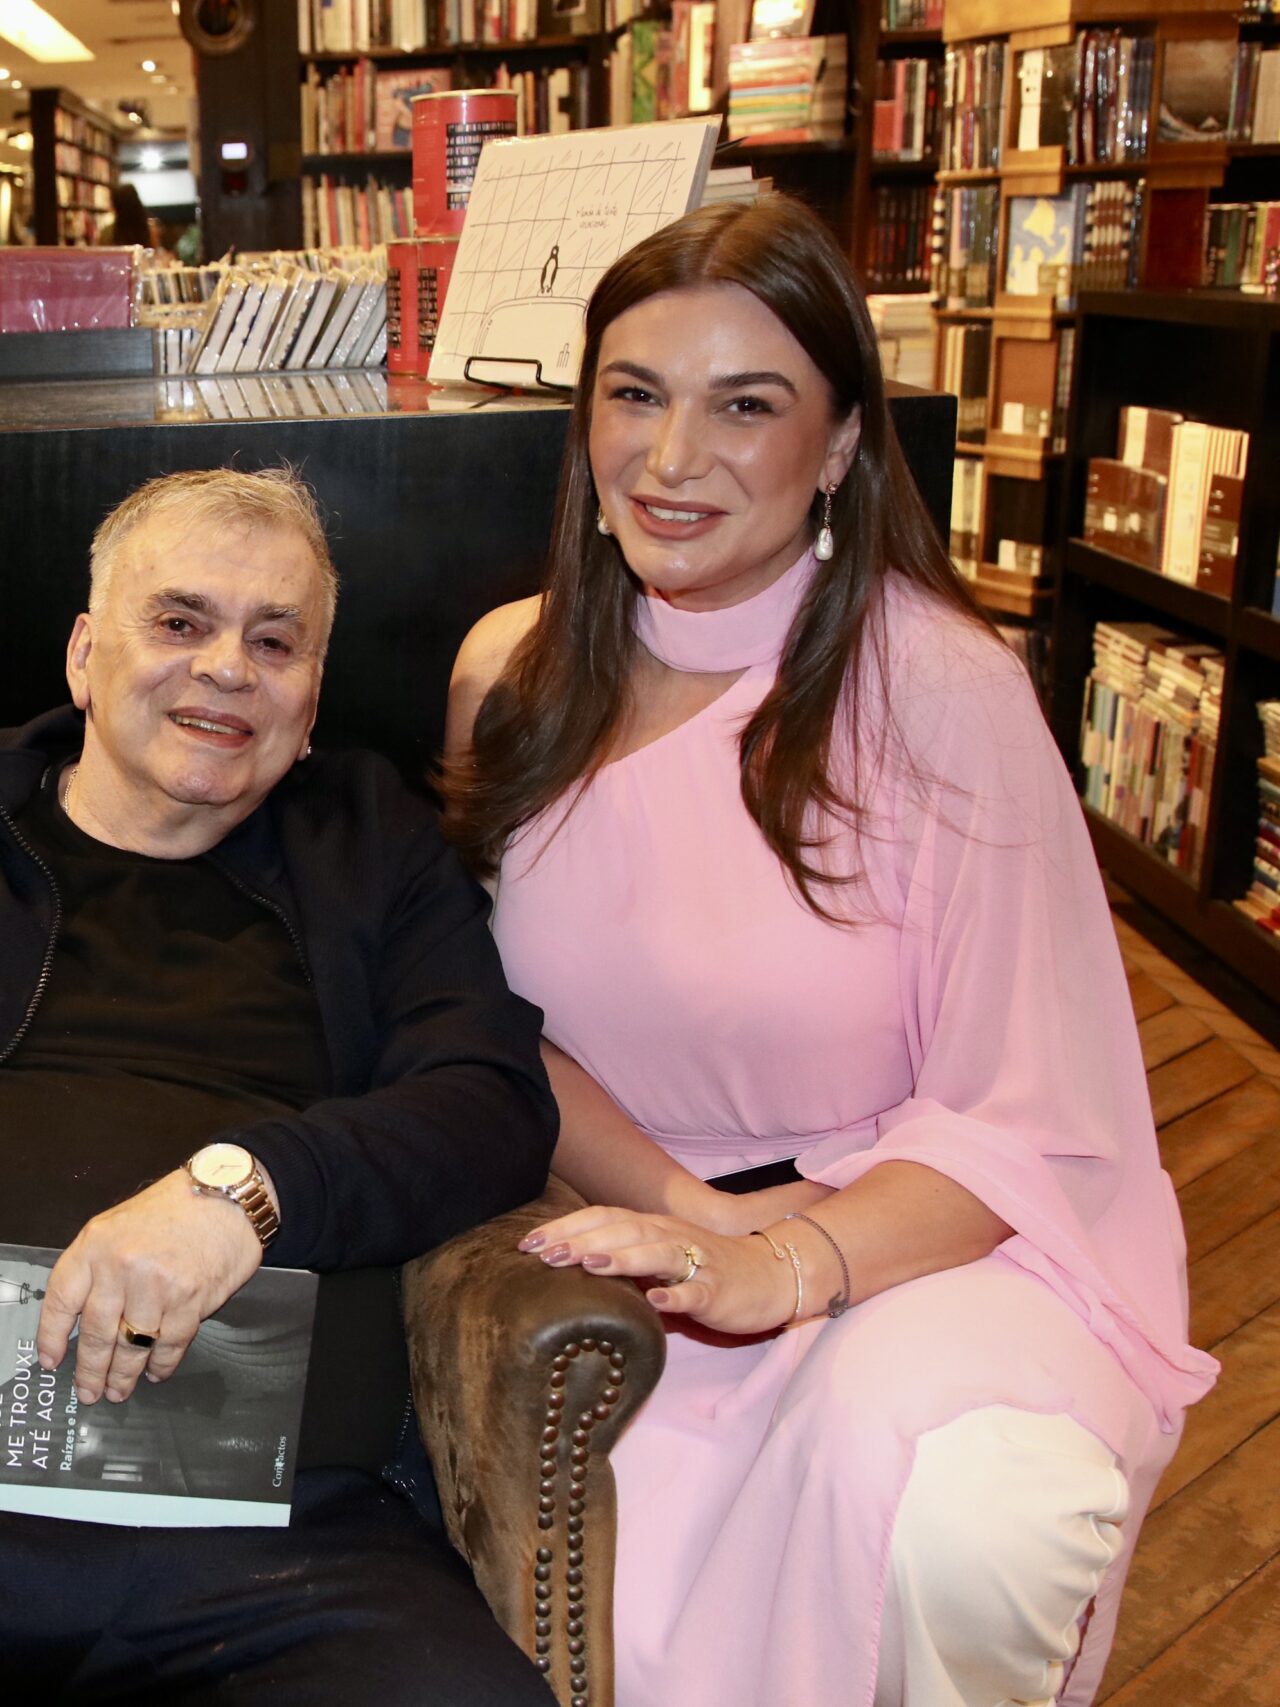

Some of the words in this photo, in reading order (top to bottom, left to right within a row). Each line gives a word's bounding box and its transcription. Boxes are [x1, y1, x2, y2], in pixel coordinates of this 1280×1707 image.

[10, 1339, 34, 1428] TROUXE
[36, 1367, 57, 1422] AQU
[6, 1435, 25, 1467] ME
[29, 1429, 51, 1470] ATÉ
[60, 1429, 75, 1471] Raízes
[68, 1417, 77, 1426] e
